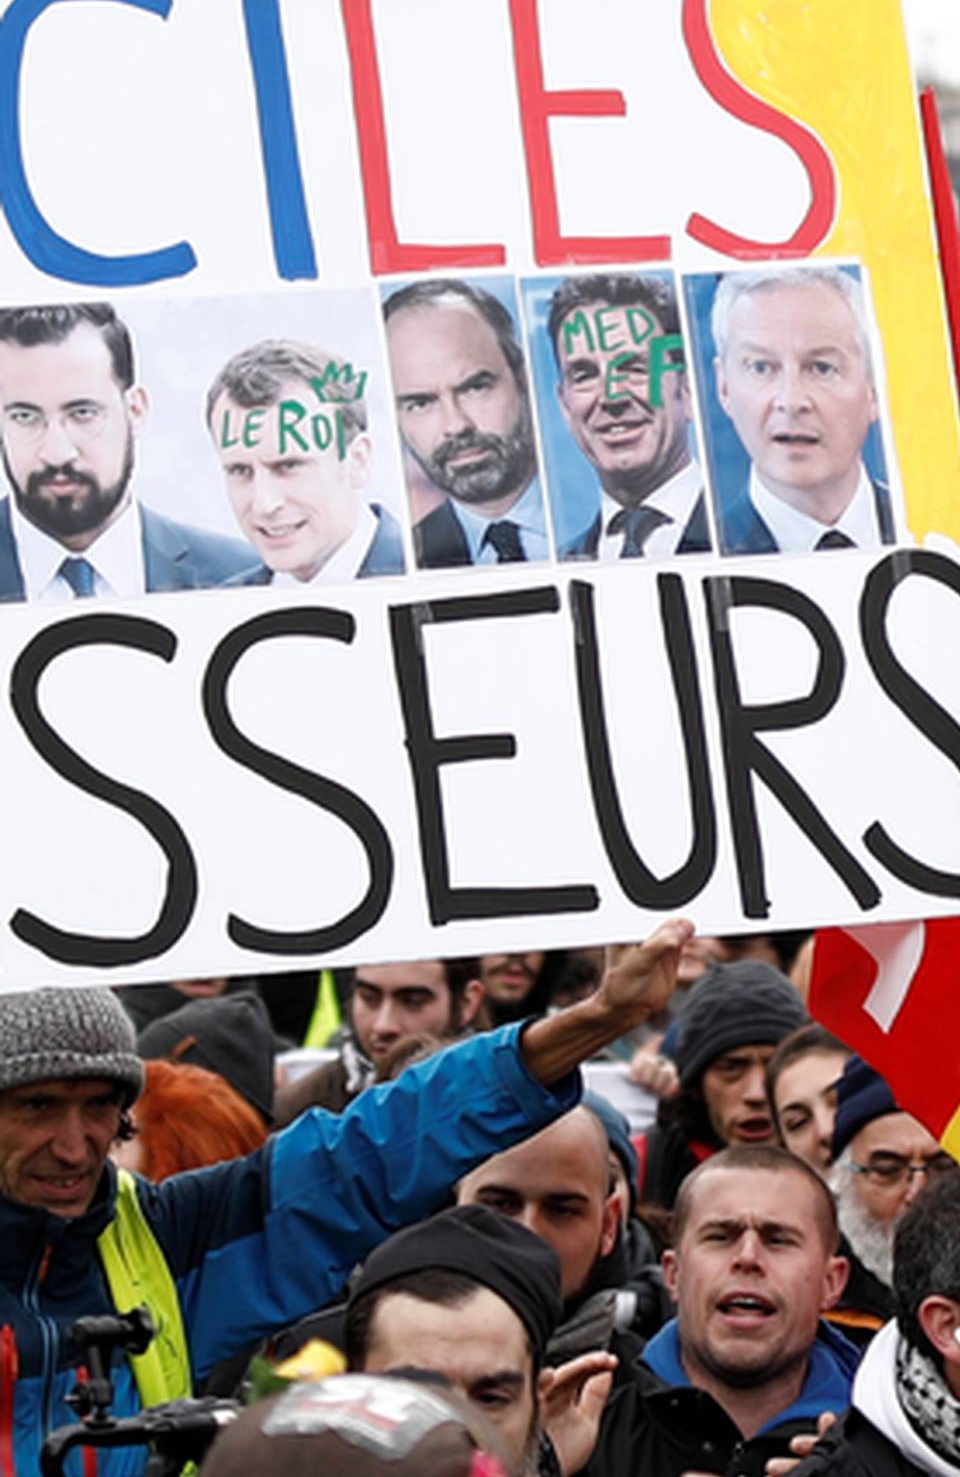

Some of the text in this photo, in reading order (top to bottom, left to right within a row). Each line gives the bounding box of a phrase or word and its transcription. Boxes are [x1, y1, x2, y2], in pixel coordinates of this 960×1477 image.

[564, 307, 656, 354] MED
[221, 399, 348, 462] LE ROI
